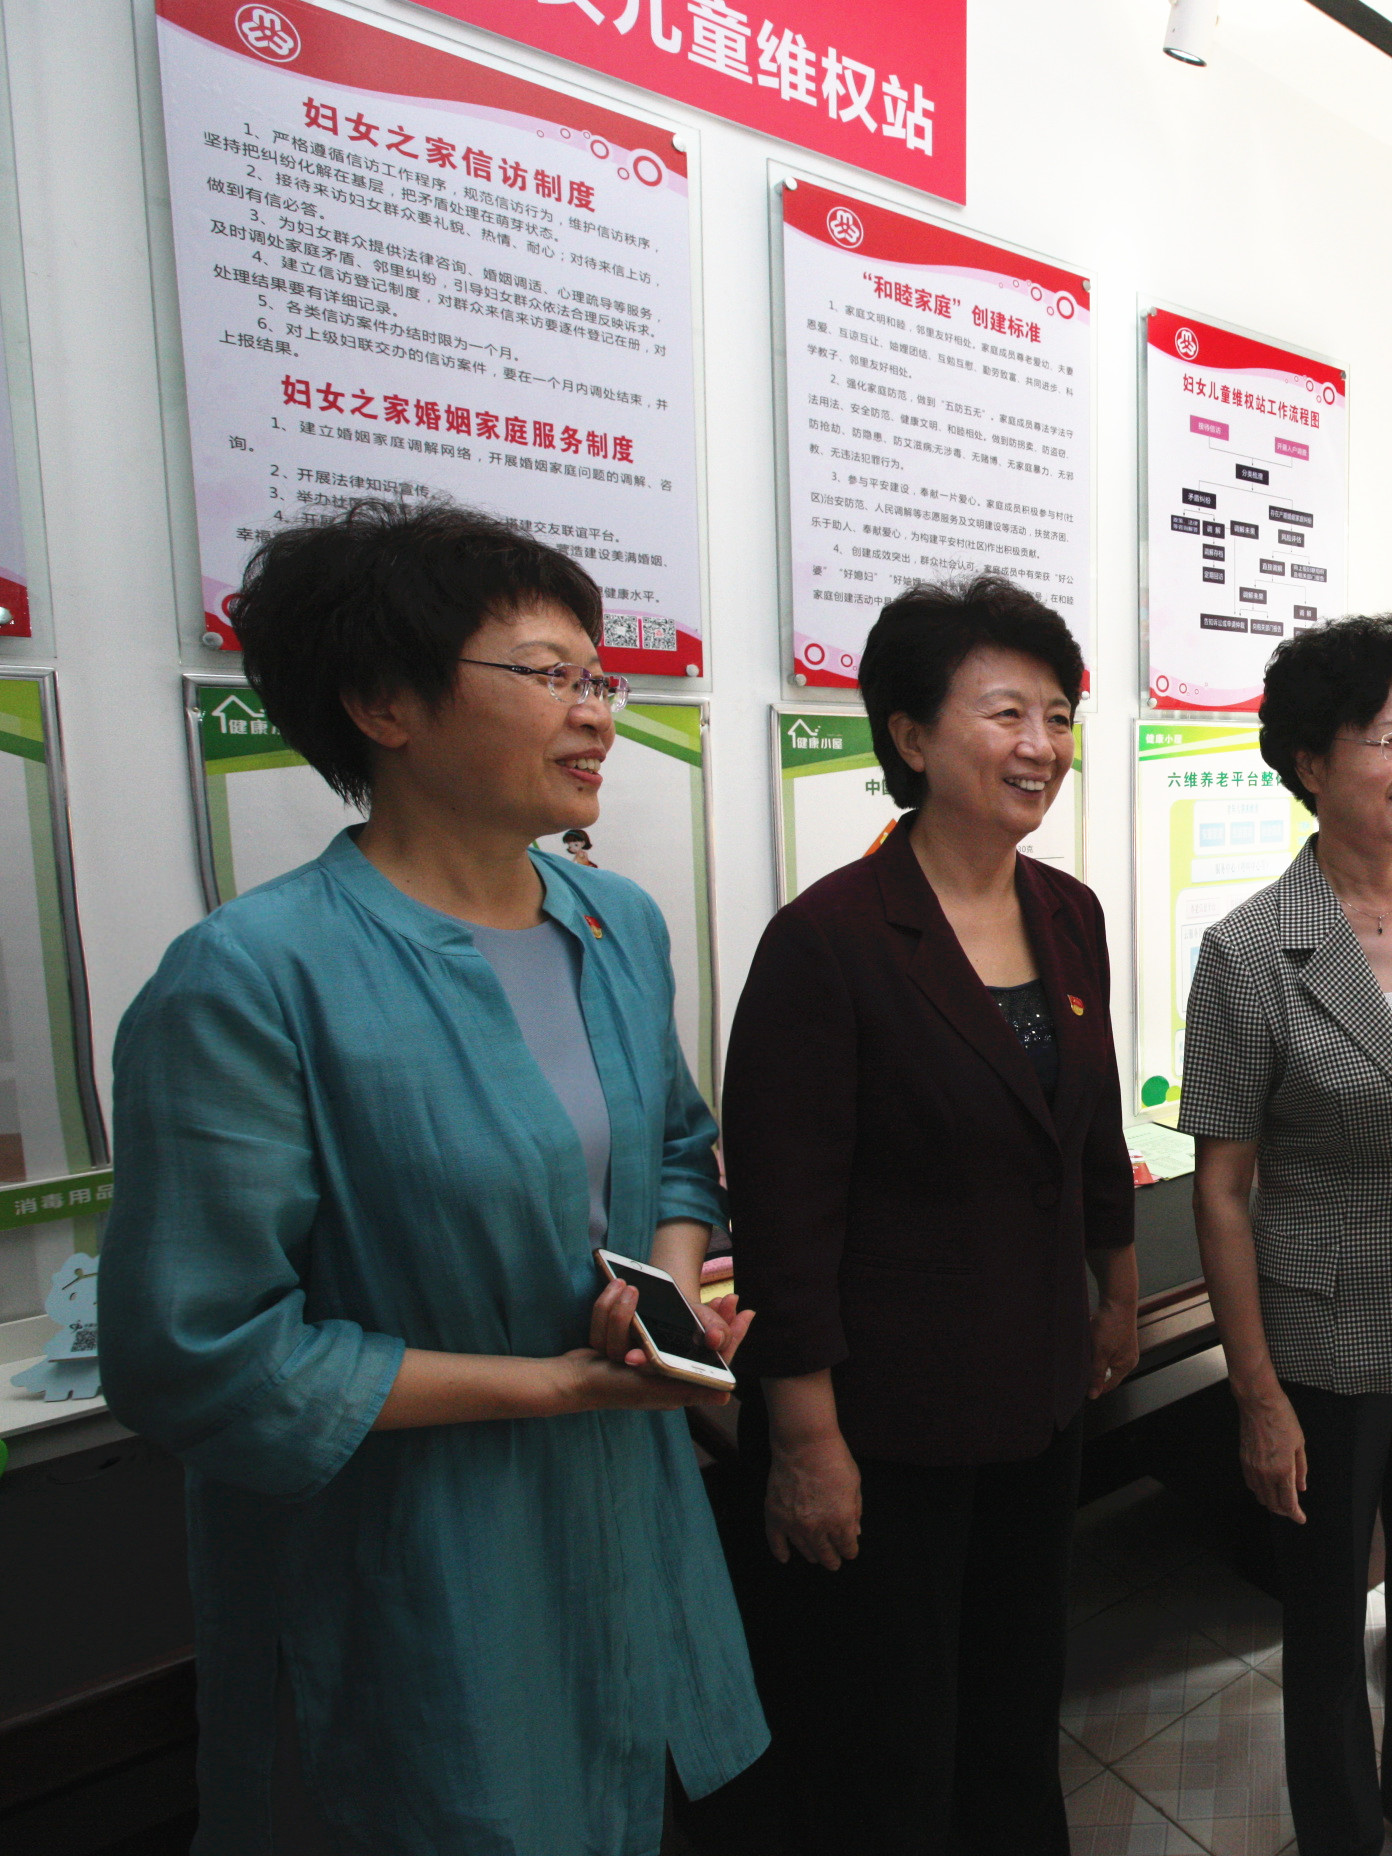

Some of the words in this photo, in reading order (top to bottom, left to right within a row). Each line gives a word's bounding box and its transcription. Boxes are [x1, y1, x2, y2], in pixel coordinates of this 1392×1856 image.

[302, 97, 596, 213] 妇女之家信访制度
[206, 177, 326, 221] 做到有信必答。
[213, 264, 400, 318] 处理结果要有详细记录。
[219, 330, 300, 358] 上报结果。
[281, 374, 635, 464] 妇女之家婚姻家庭服务制度
[1182, 373, 1321, 430] 妇女儿童维权站工作流程图
[228, 435, 255, 453] 询。
[796, 736, 843, 750] 健康小屋
